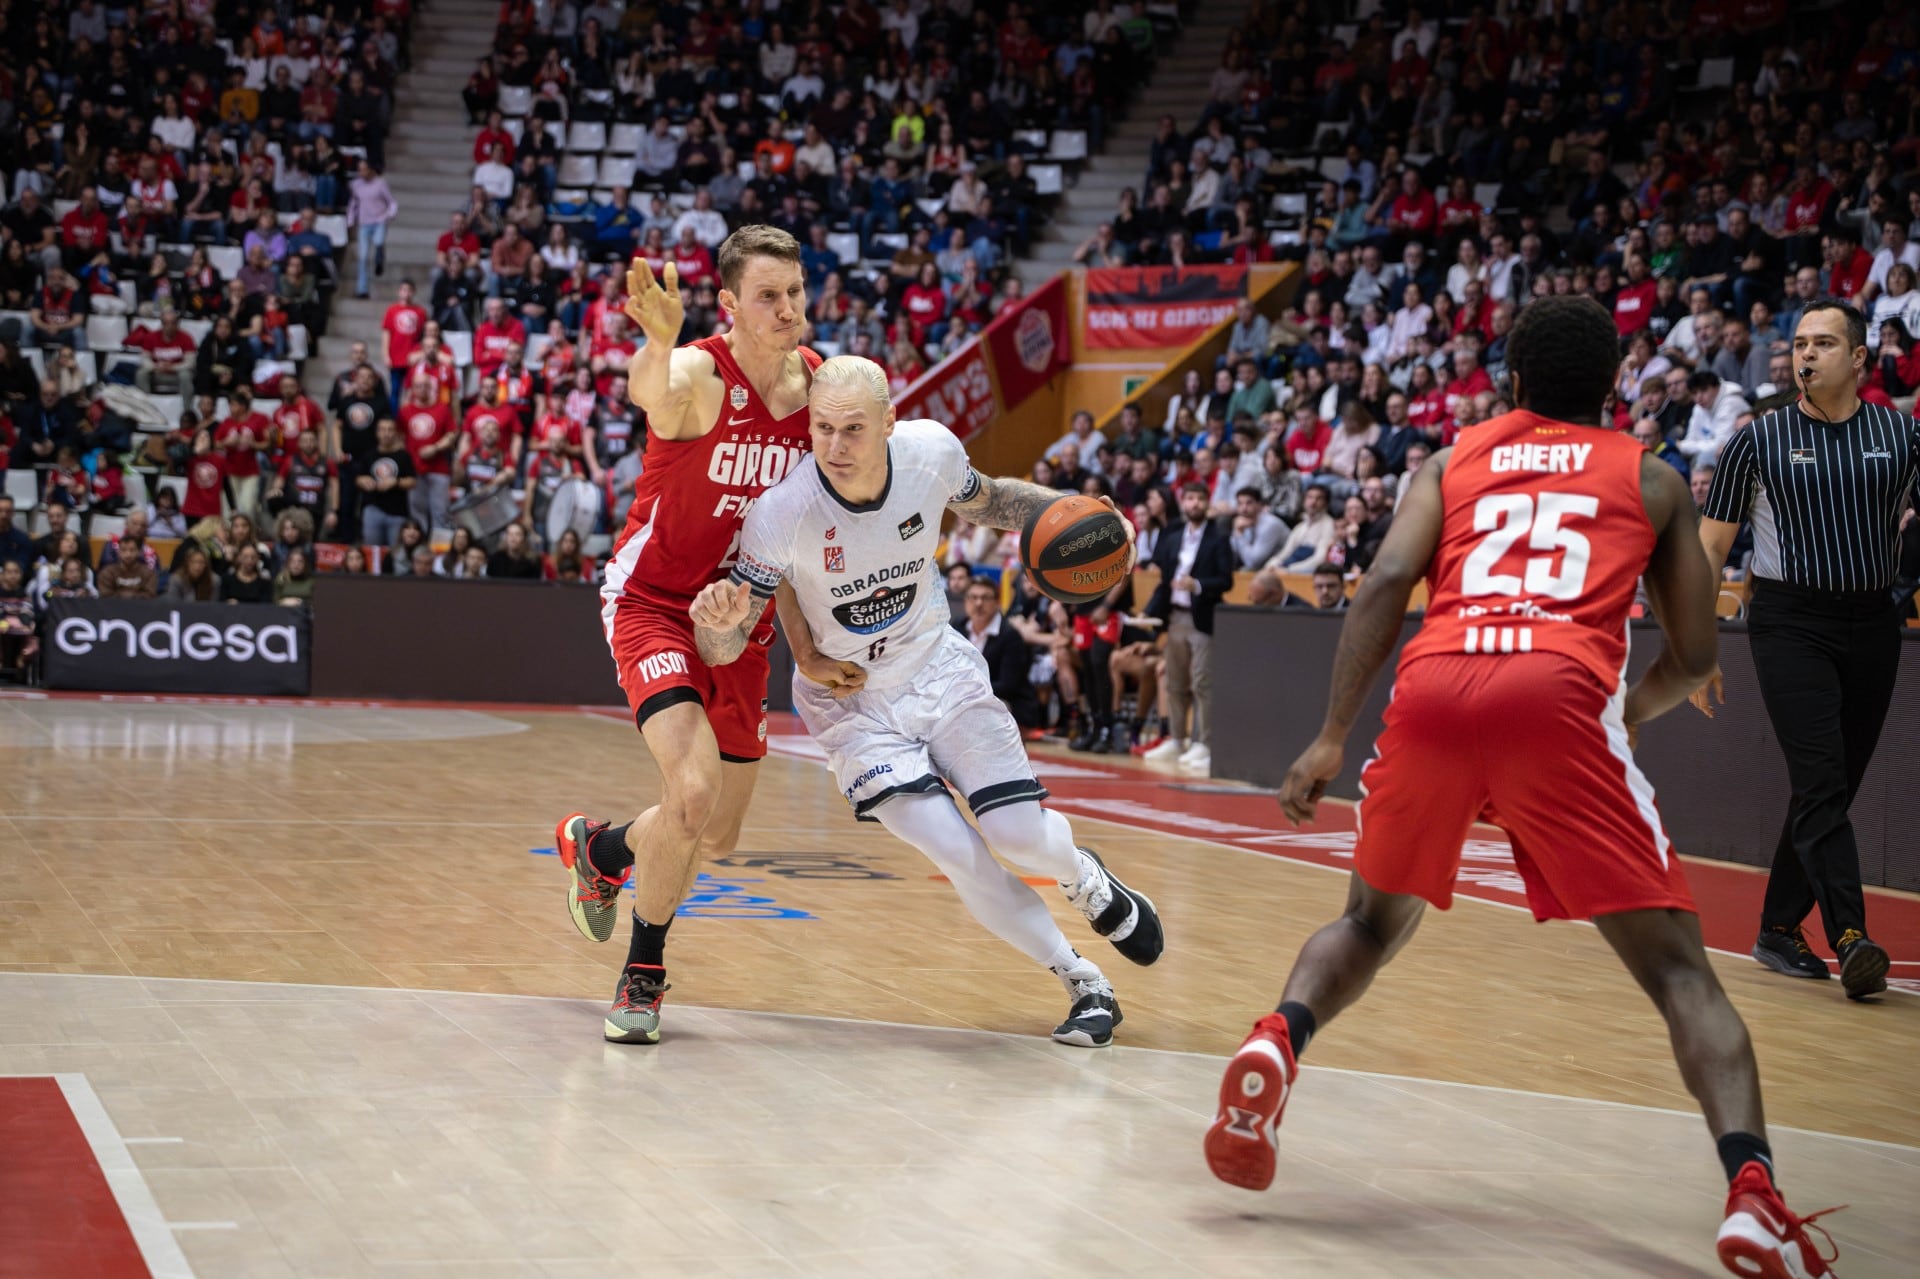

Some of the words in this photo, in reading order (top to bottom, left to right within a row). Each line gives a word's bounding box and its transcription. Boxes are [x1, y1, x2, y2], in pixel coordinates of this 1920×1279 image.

[707, 442, 809, 488] GIRON
[1490, 443, 1592, 473] CHERY
[1461, 491, 1599, 602] 25
[831, 557, 925, 598] OBRADOIRO
[850, 602, 905, 626] Galicia
[55, 610, 298, 663] endesa
